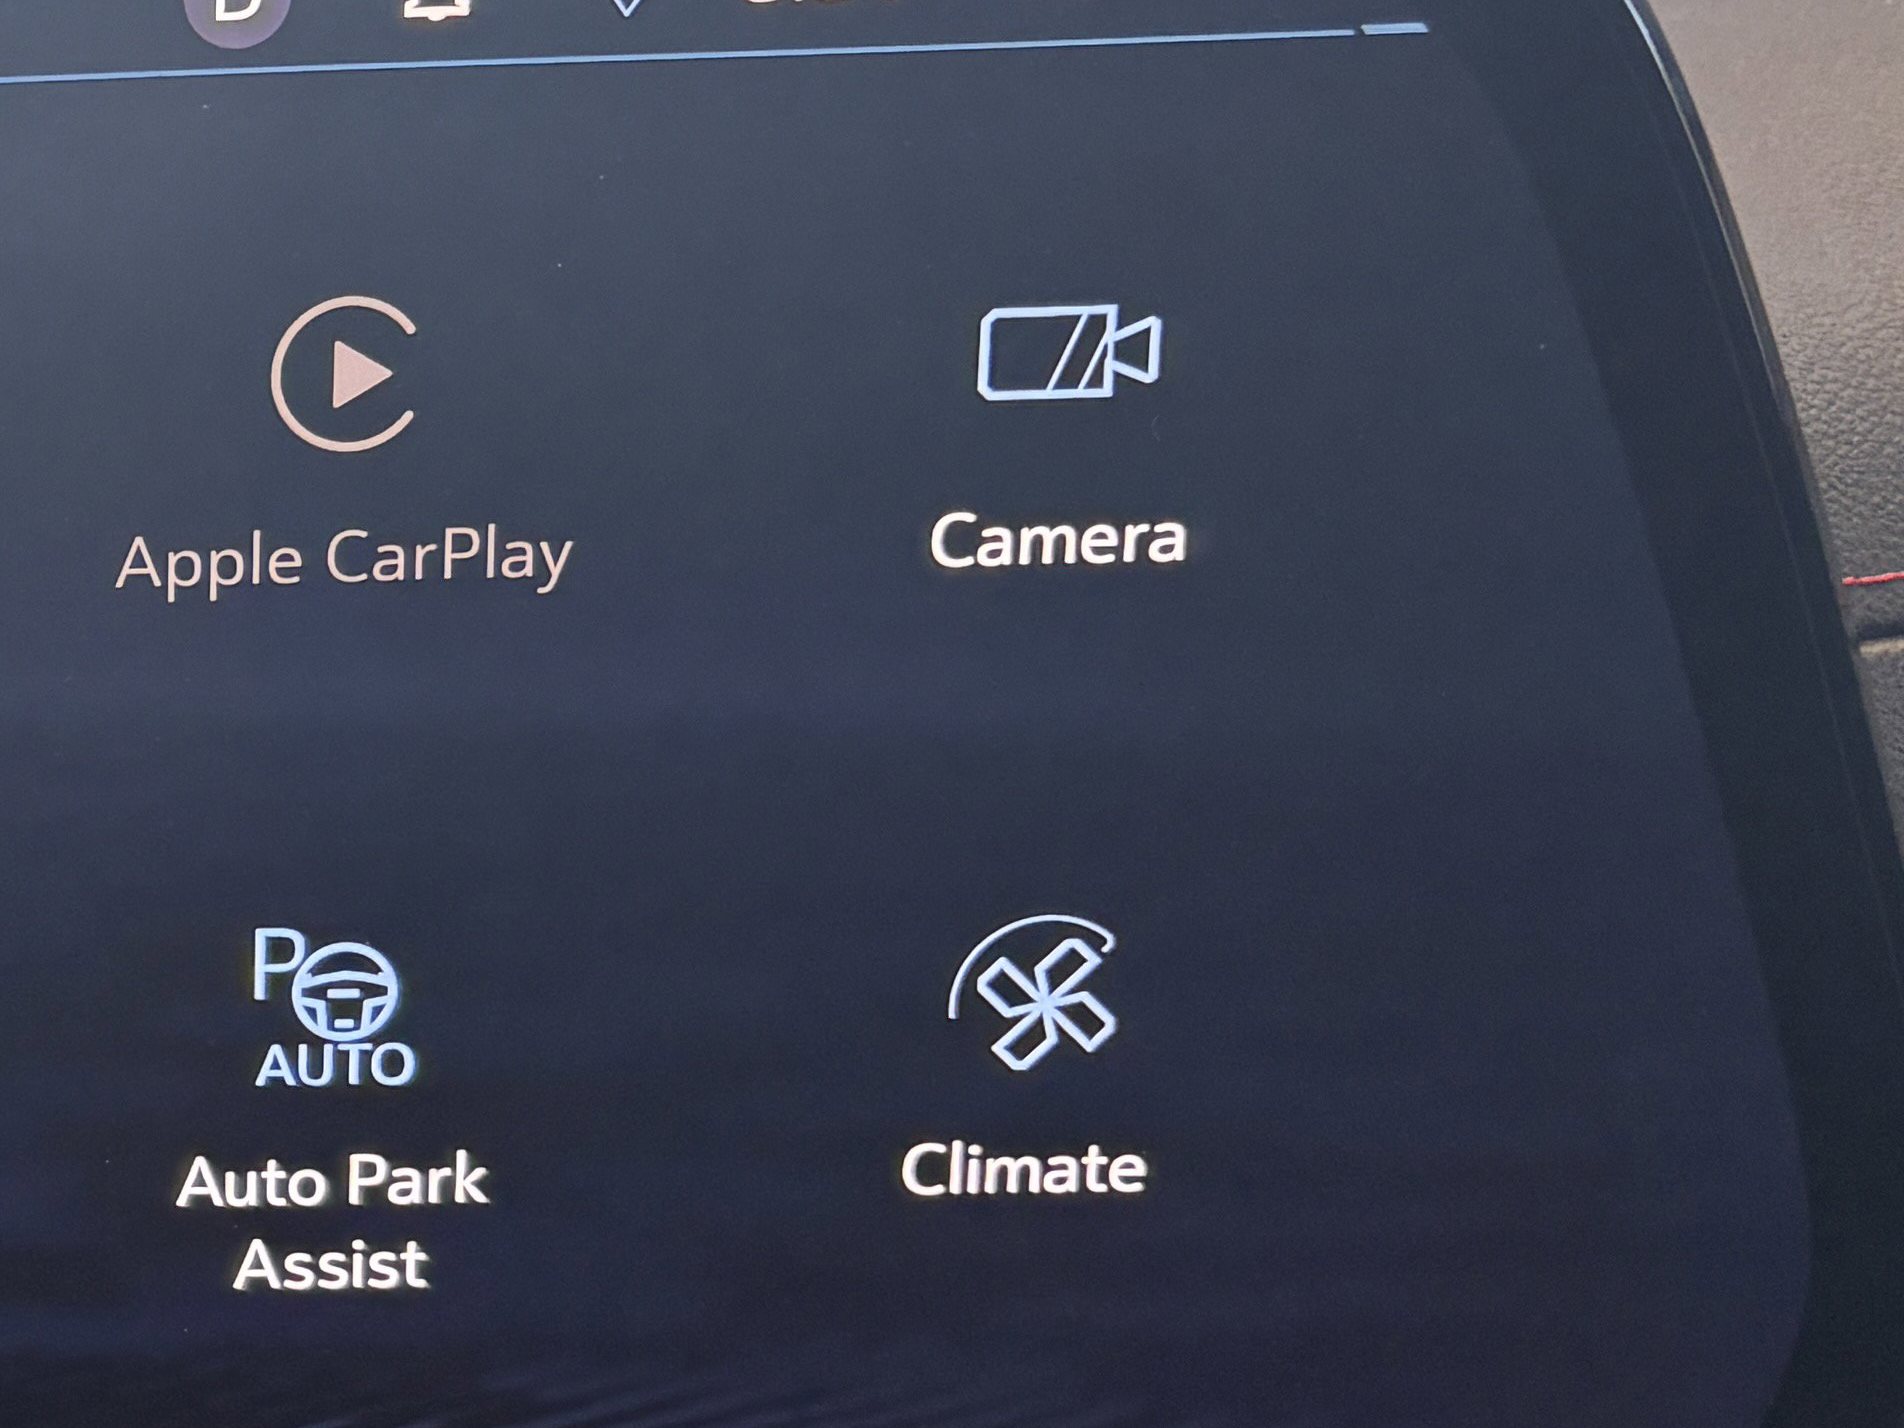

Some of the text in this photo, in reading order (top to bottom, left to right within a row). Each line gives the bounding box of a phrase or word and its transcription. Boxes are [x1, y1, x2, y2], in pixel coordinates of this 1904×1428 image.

[116, 524, 573, 602] Apple CarPlay
[932, 512, 1186, 568] Camera
[253, 927, 305, 1001] P
[255, 1042, 416, 1087] AUTO
[176, 1149, 489, 1207] Auto Park
[902, 1140, 1147, 1196] Climate
[233, 1239, 428, 1290] Assist
